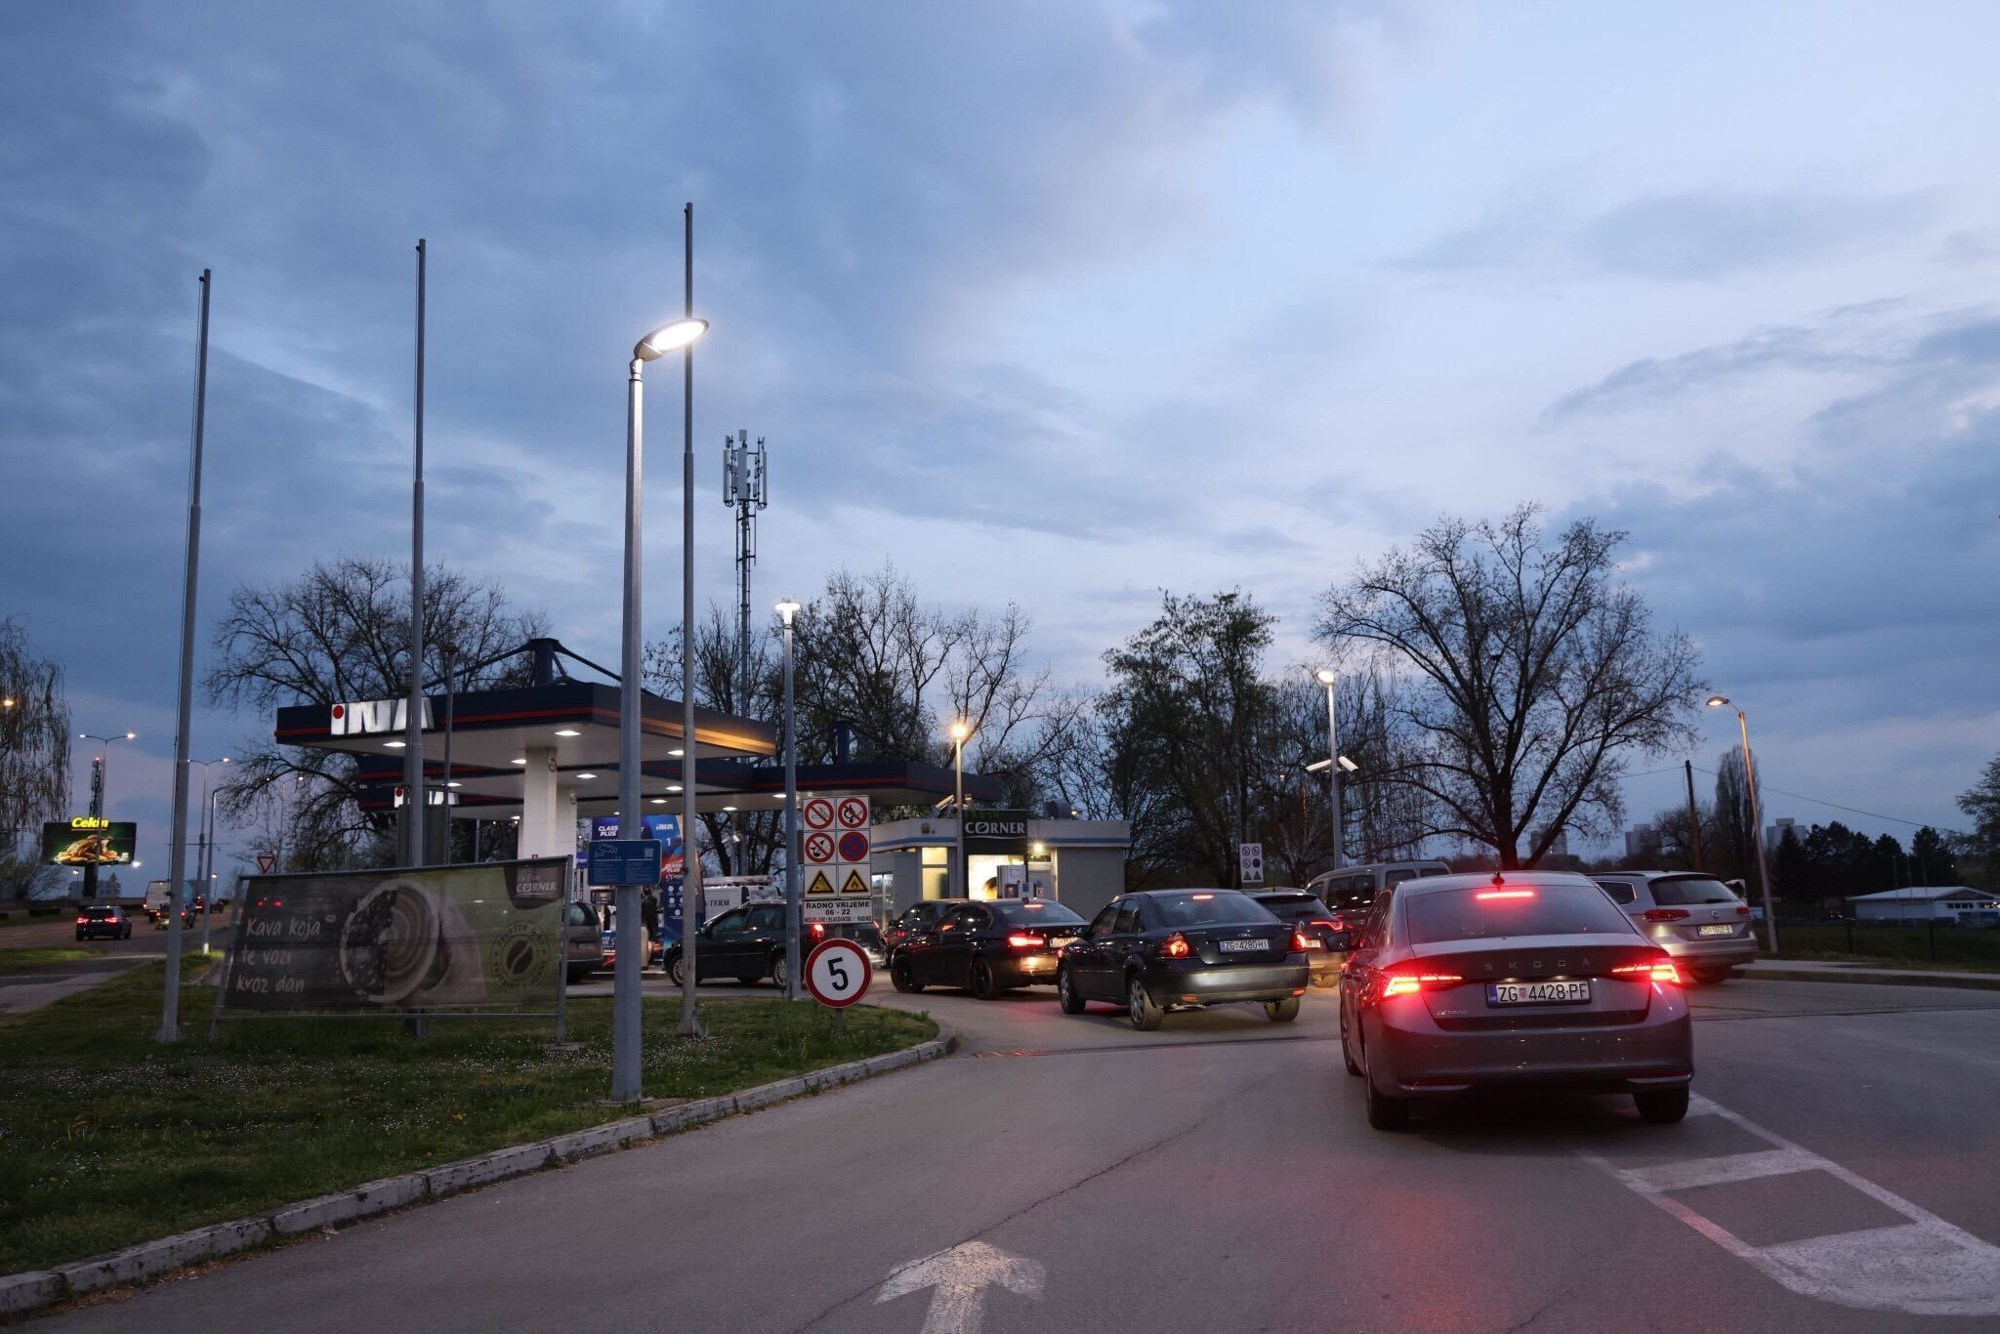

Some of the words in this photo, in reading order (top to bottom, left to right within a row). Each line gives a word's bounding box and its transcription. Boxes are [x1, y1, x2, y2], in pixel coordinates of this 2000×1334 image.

[71, 817, 109, 828] Cekin
[965, 822, 1026, 834] CORNER
[516, 881, 556, 893] CORNER
[246, 919, 282, 936] Kava
[288, 916, 321, 940] koja
[242, 944, 256, 965] te
[827, 956, 849, 991] 5
[275, 974, 305, 993] dan
[1498, 986, 1518, 1001] ZG
